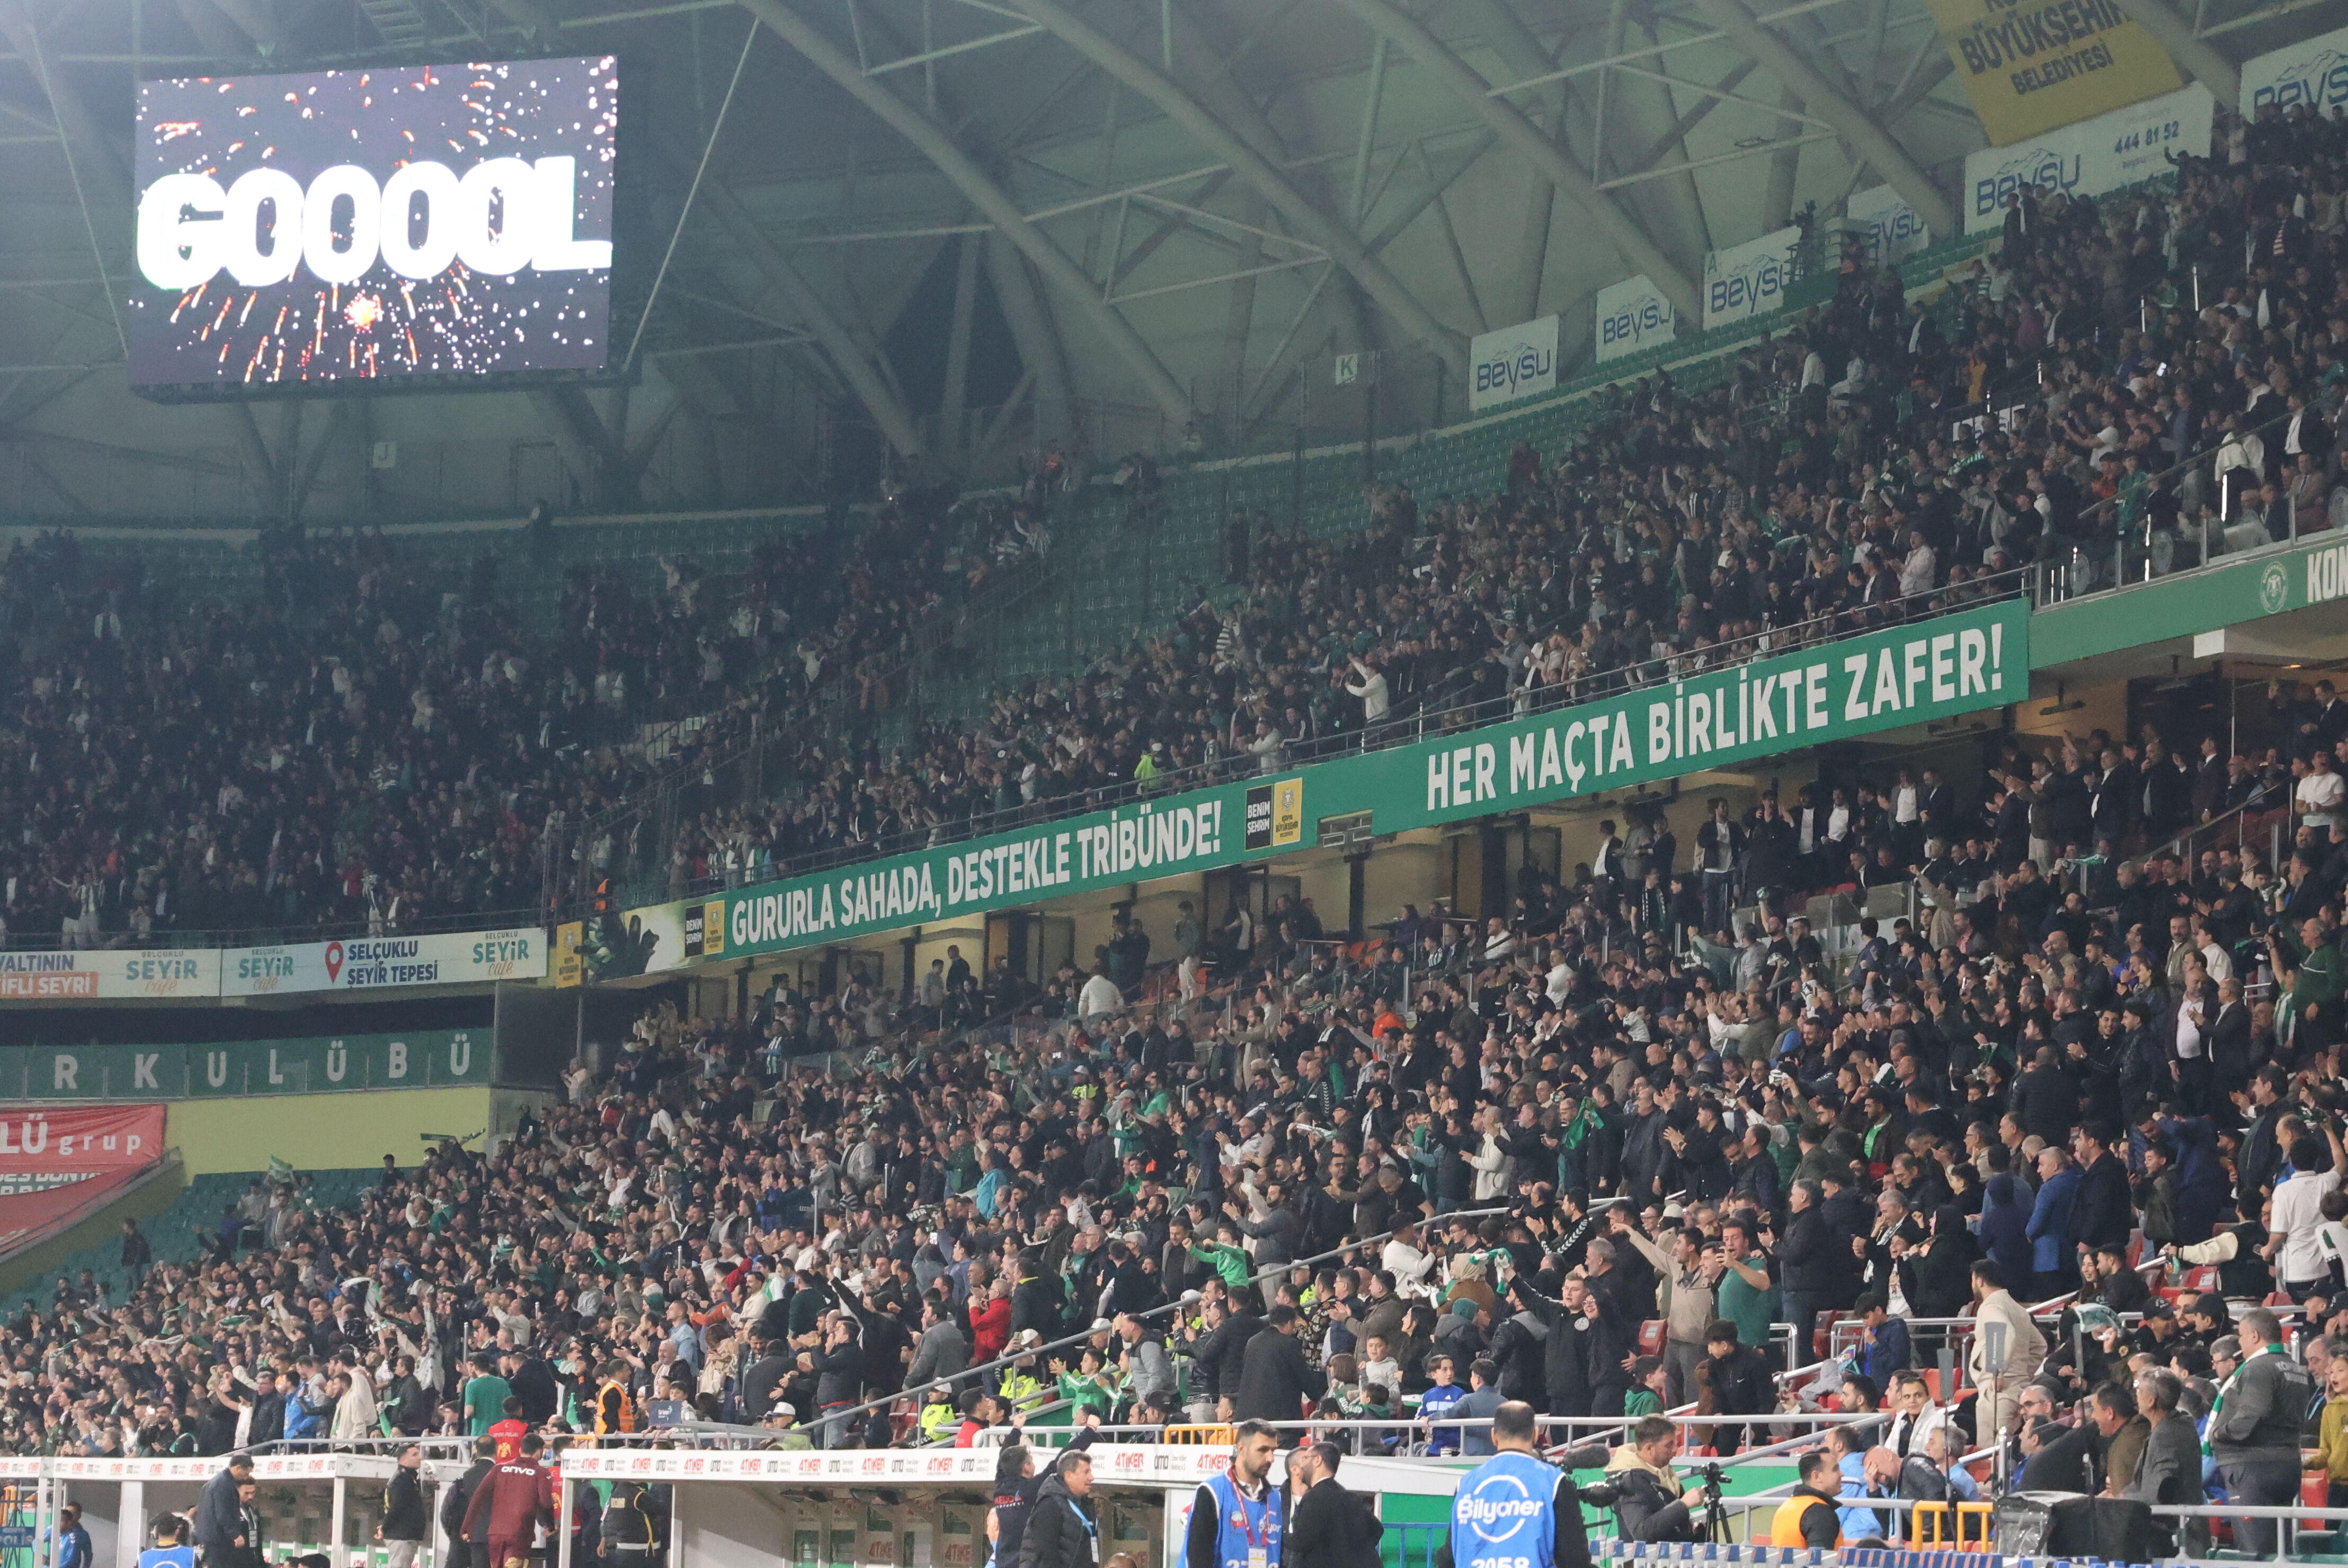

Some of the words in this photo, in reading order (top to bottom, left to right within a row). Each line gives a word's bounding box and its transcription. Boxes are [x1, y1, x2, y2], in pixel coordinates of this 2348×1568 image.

[2115, 132, 2139, 154] 444
[2164, 120, 2179, 140] 52
[137, 156, 612, 289] GOOOL
[1341, 357, 1354, 376] K
[1427, 742, 1496, 812] HER
[1510, 710, 1633, 794] MAÇTA
[1649, 666, 1828, 765] BİRLİKTE
[1844, 623, 2003, 721] ZAFER!
[732, 884, 835, 946] GURURLA
[840, 862, 941, 926] SAHADA,
[948, 833, 1070, 905] DESTEKLE
[1077, 800, 1222, 879] TRİBÜNDE!
[348, 940, 419, 962] SELÇUKLU
[38, 972, 91, 994] SEYRİ
[391, 960, 438, 983] TEPESİ
[59, 1135, 141, 1156] grup
[1457, 1494, 1544, 1524] Bilyoner
